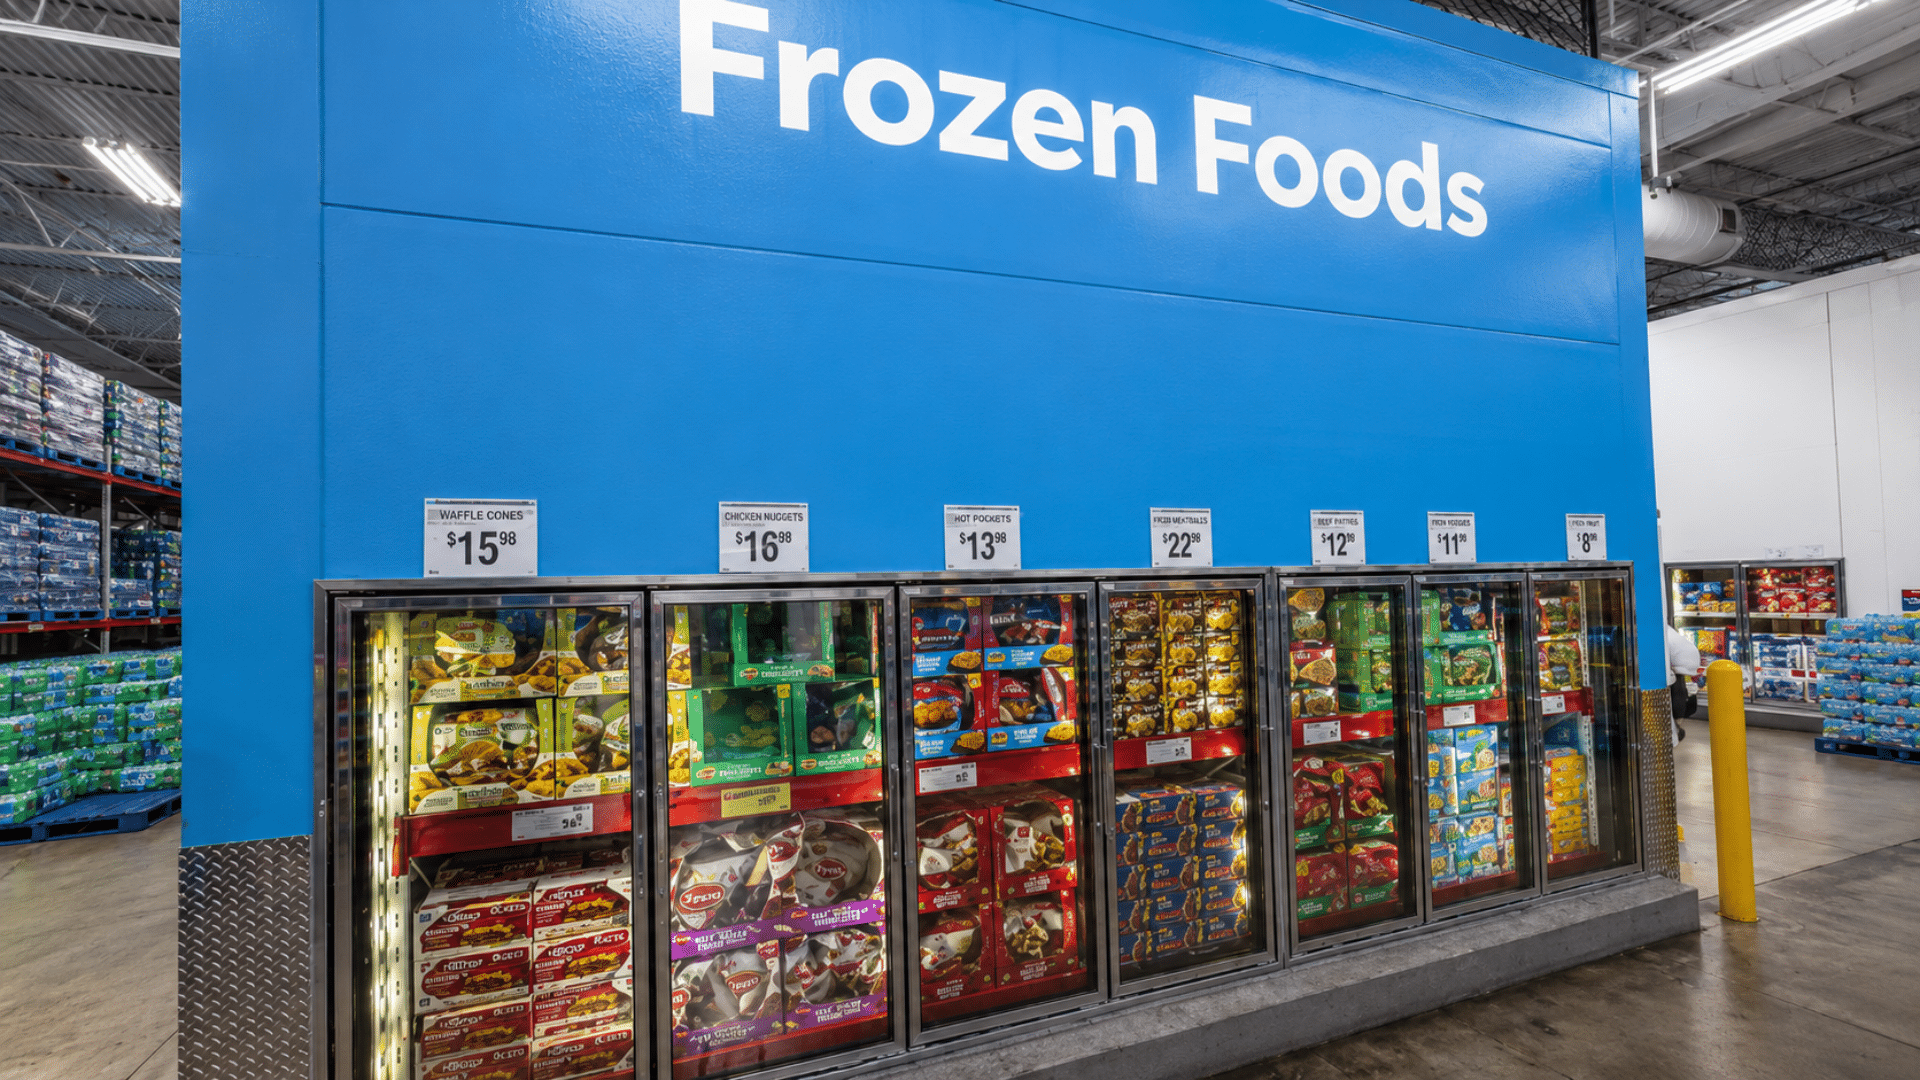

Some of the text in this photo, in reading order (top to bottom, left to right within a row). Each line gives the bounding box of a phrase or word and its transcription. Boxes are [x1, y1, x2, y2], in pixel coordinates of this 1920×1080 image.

[679, 0, 1488, 238] Frozen Foods
[440, 509, 524, 520] WAFFLE CONES
[724, 511, 804, 522] CHICKEN NUGGETS
[954, 514, 1011, 523] HOT POCKETS
